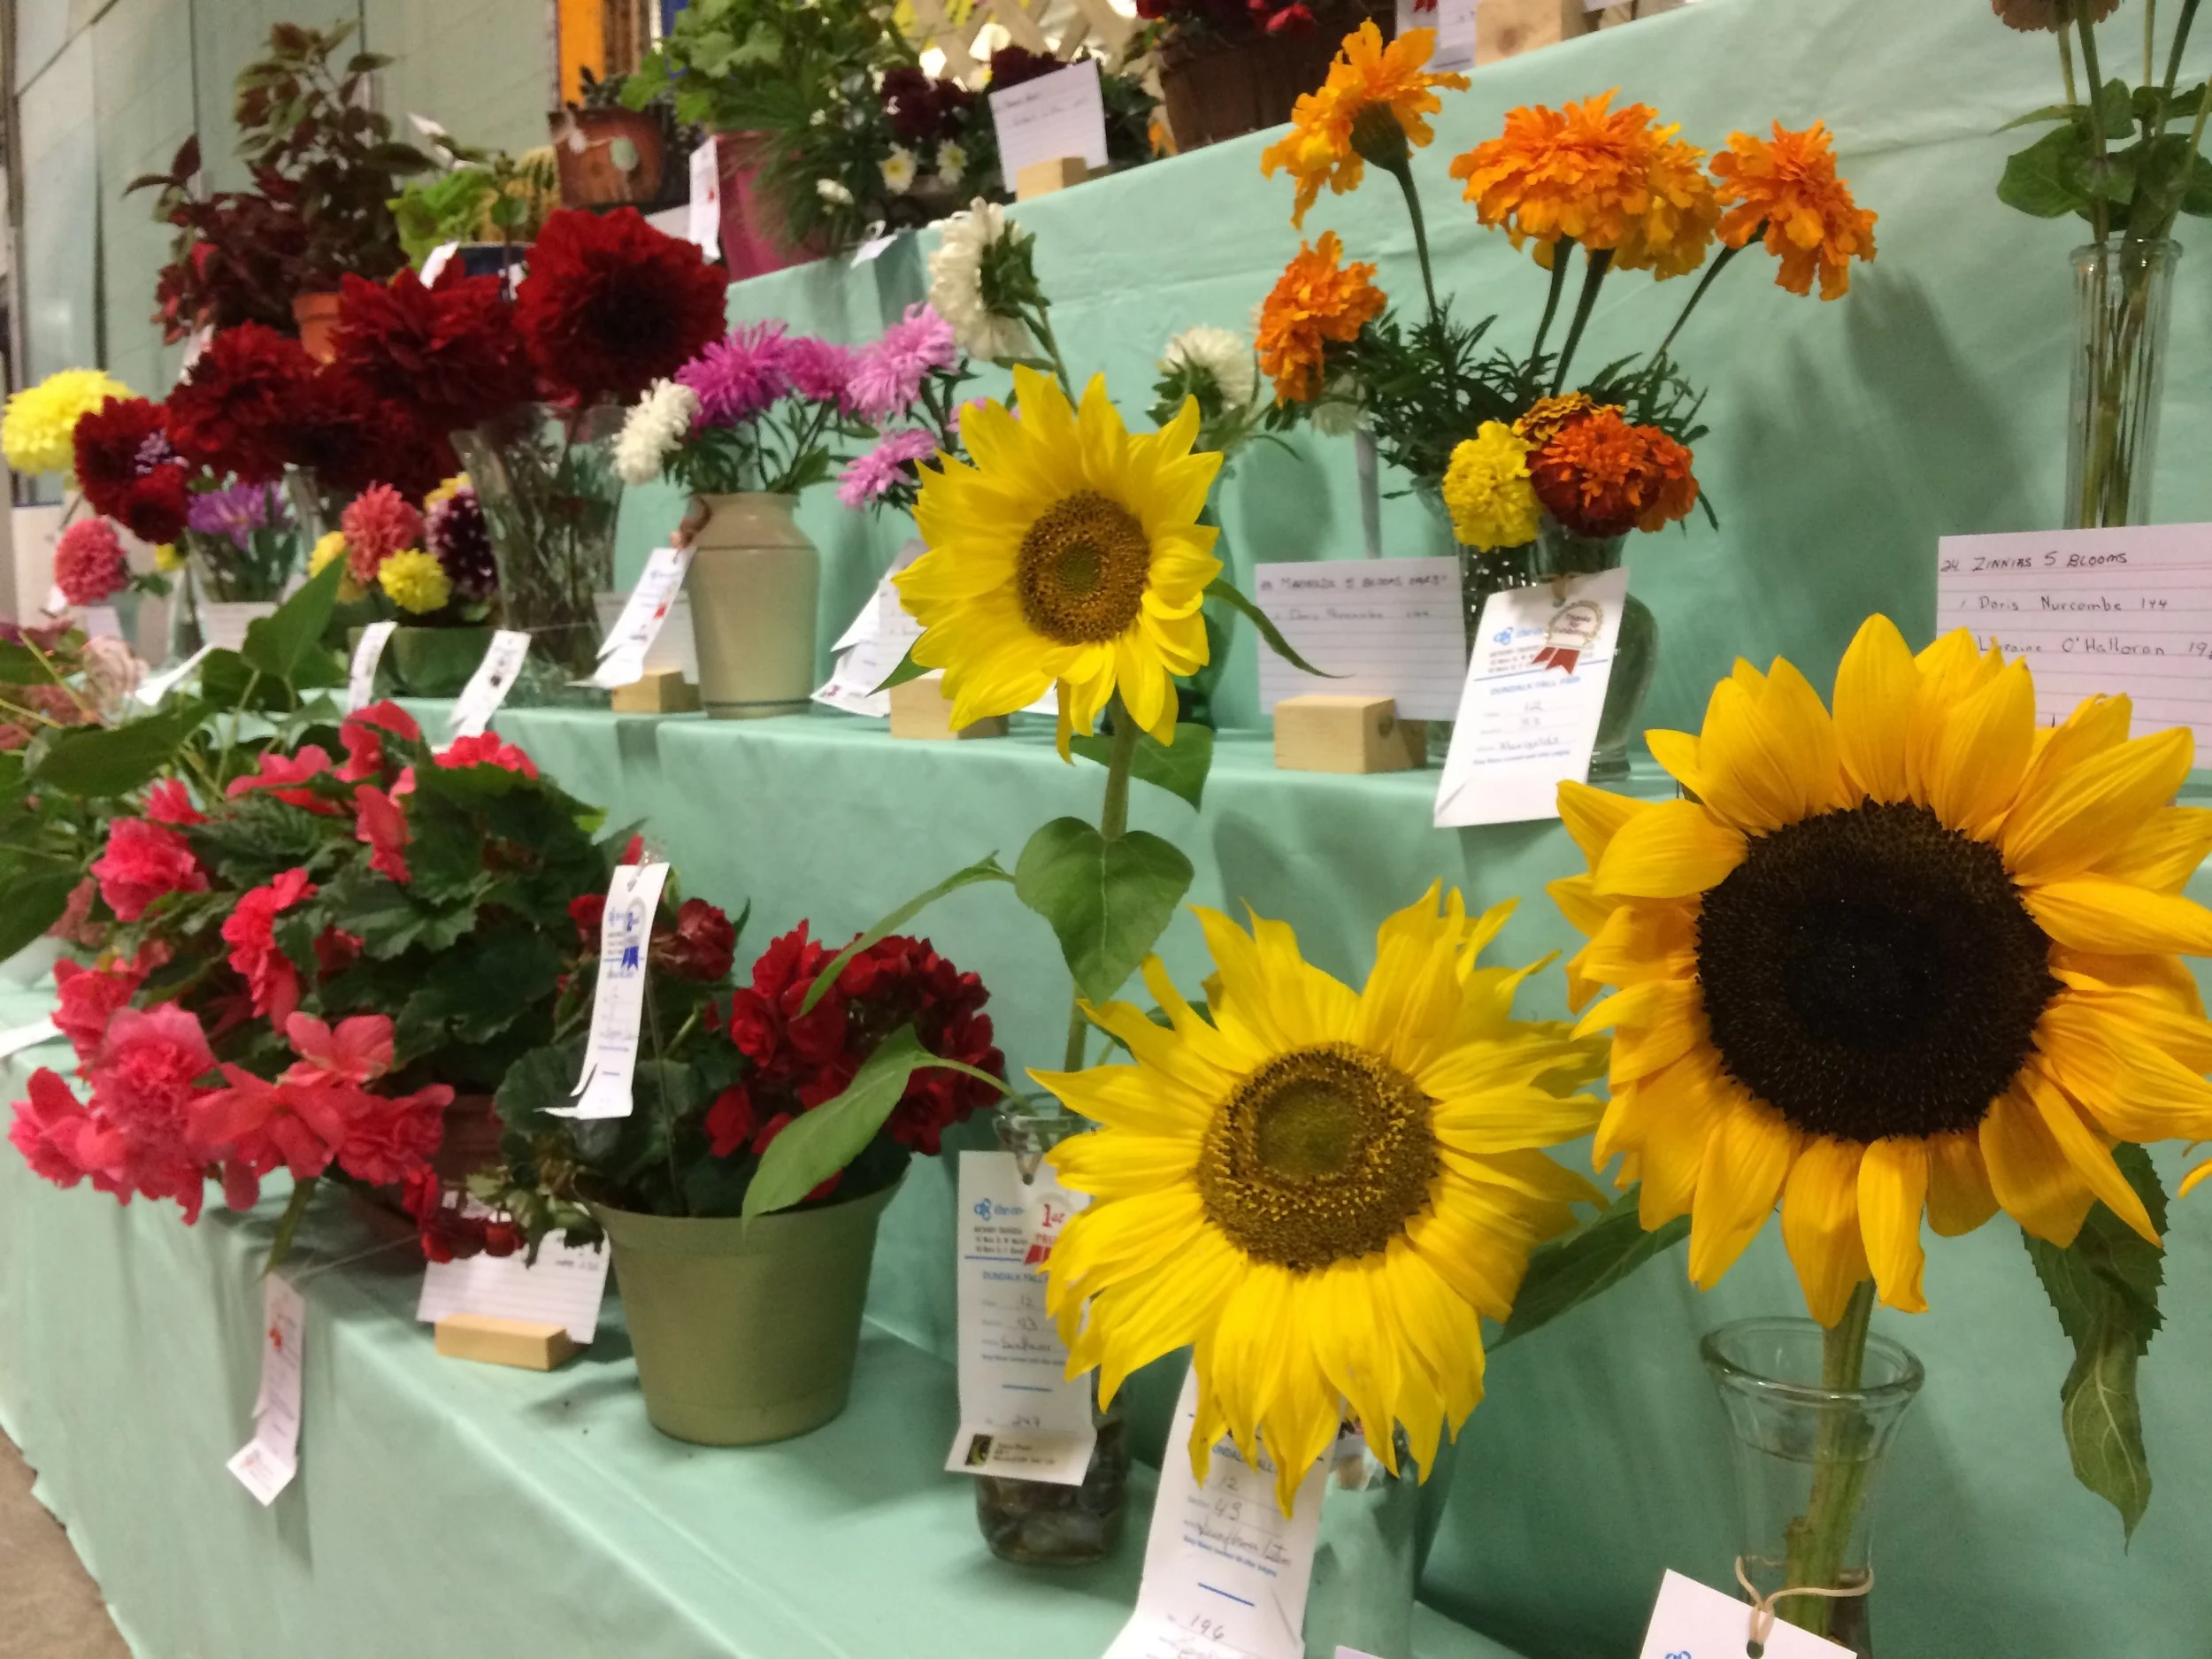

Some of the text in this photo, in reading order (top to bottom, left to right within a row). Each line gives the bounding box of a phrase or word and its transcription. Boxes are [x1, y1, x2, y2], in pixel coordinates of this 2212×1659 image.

[1940, 550, 2128, 572] 24 ZINNIAS 5 BLOOMS
[1978, 595, 2019, 611] Doris
[2041, 595, 2122, 611] Nurcombe
[1978, 636, 2042, 653] Lraine
[1191, 1612, 1225, 1641] 196
